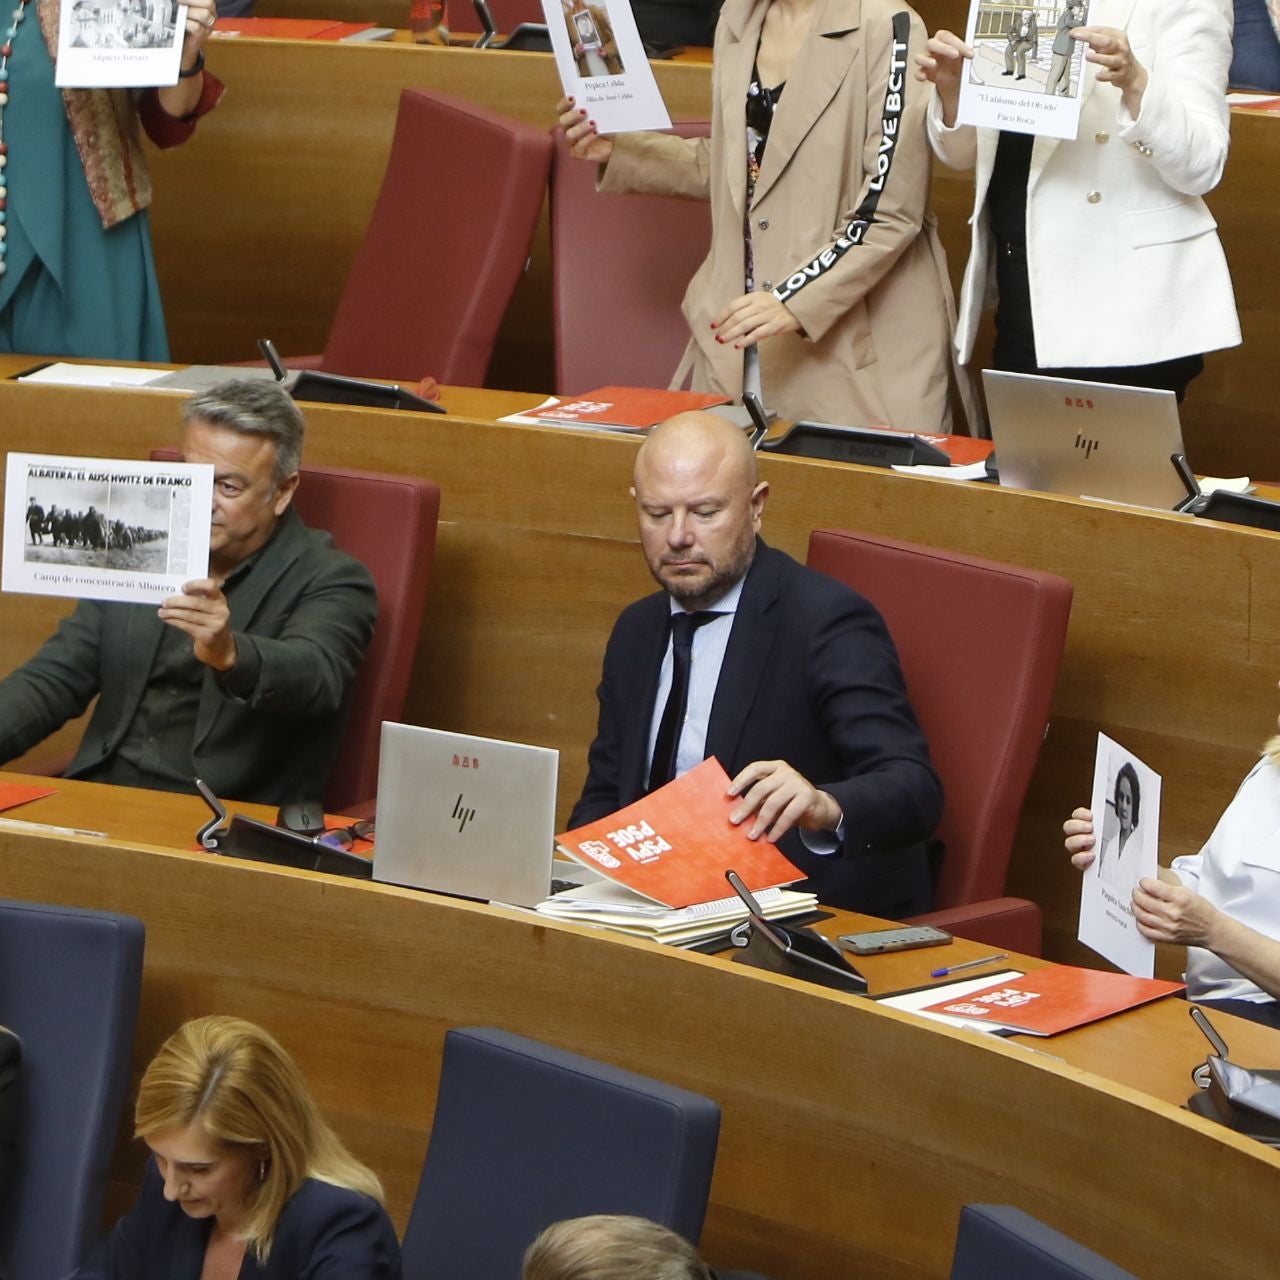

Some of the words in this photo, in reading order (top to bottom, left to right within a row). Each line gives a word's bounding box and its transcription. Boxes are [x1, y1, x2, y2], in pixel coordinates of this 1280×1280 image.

[990, 95, 1017, 106] abismo
[1018, 98, 1030, 108] del
[870, 117, 898, 192] LOVE
[885, 39, 907, 113] BCTT
[997, 113, 1015, 122] Paco
[1016, 115, 1035, 125] Roca
[773, 248, 838, 302] LOVE
[77, 471, 86, 481] EL
[88, 472, 141, 484] AUSCHWITZ
[143, 476, 153, 485] DE
[156, 477, 192, 487] FRANCO
[34, 572, 60, 584] Camp
[62, 574, 73, 583] de
[76, 576, 135, 589] concentració
[138, 581, 176, 593] Albatera
[452, 793, 475, 833] hp
[606, 819, 656, 848] PSOE
[625, 835, 672, 861] PSPV
